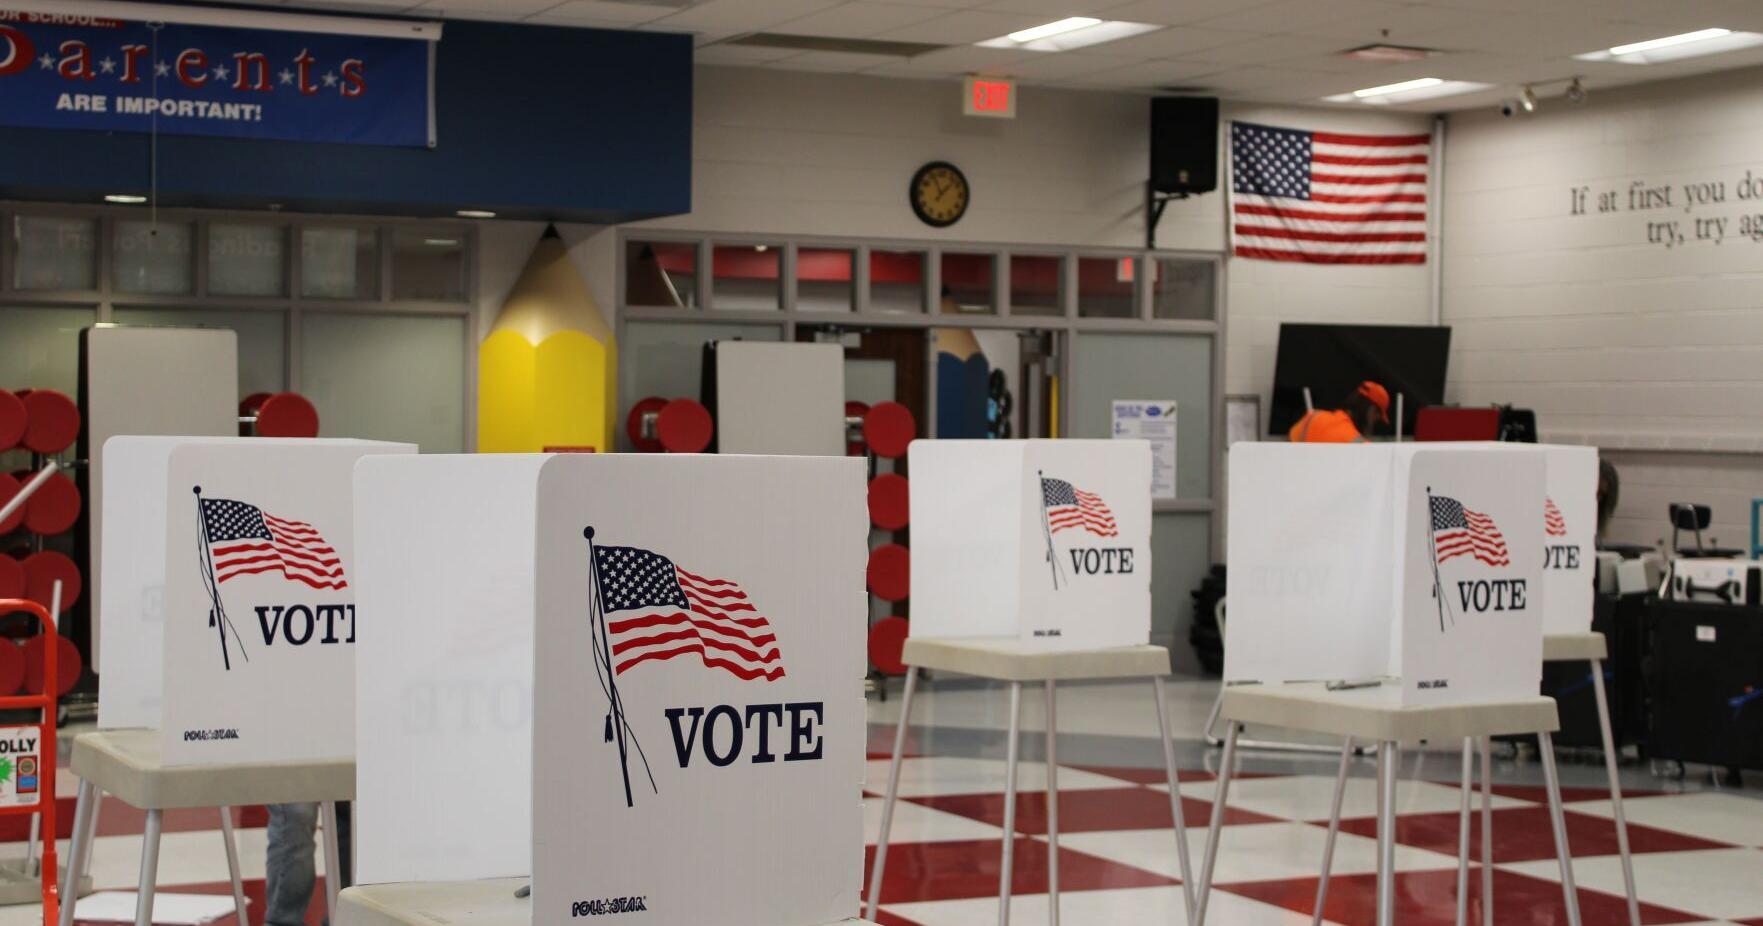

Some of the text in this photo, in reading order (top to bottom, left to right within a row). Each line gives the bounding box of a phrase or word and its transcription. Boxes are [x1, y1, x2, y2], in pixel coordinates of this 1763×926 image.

[56, 93, 262, 121] ARE IMPORTANT!
[973, 80, 1009, 112] EXIT
[1570, 186, 1590, 215] If
[1598, 190, 1618, 212] at
[1628, 181, 1672, 211] first
[1684, 182, 1725, 213] you
[1647, 220, 1684, 248] try,
[1696, 217, 1728, 245] try
[1070, 547, 1134, 574] VOTE
[1457, 579, 1526, 612] VOTE
[665, 702, 824, 768] VOTE
